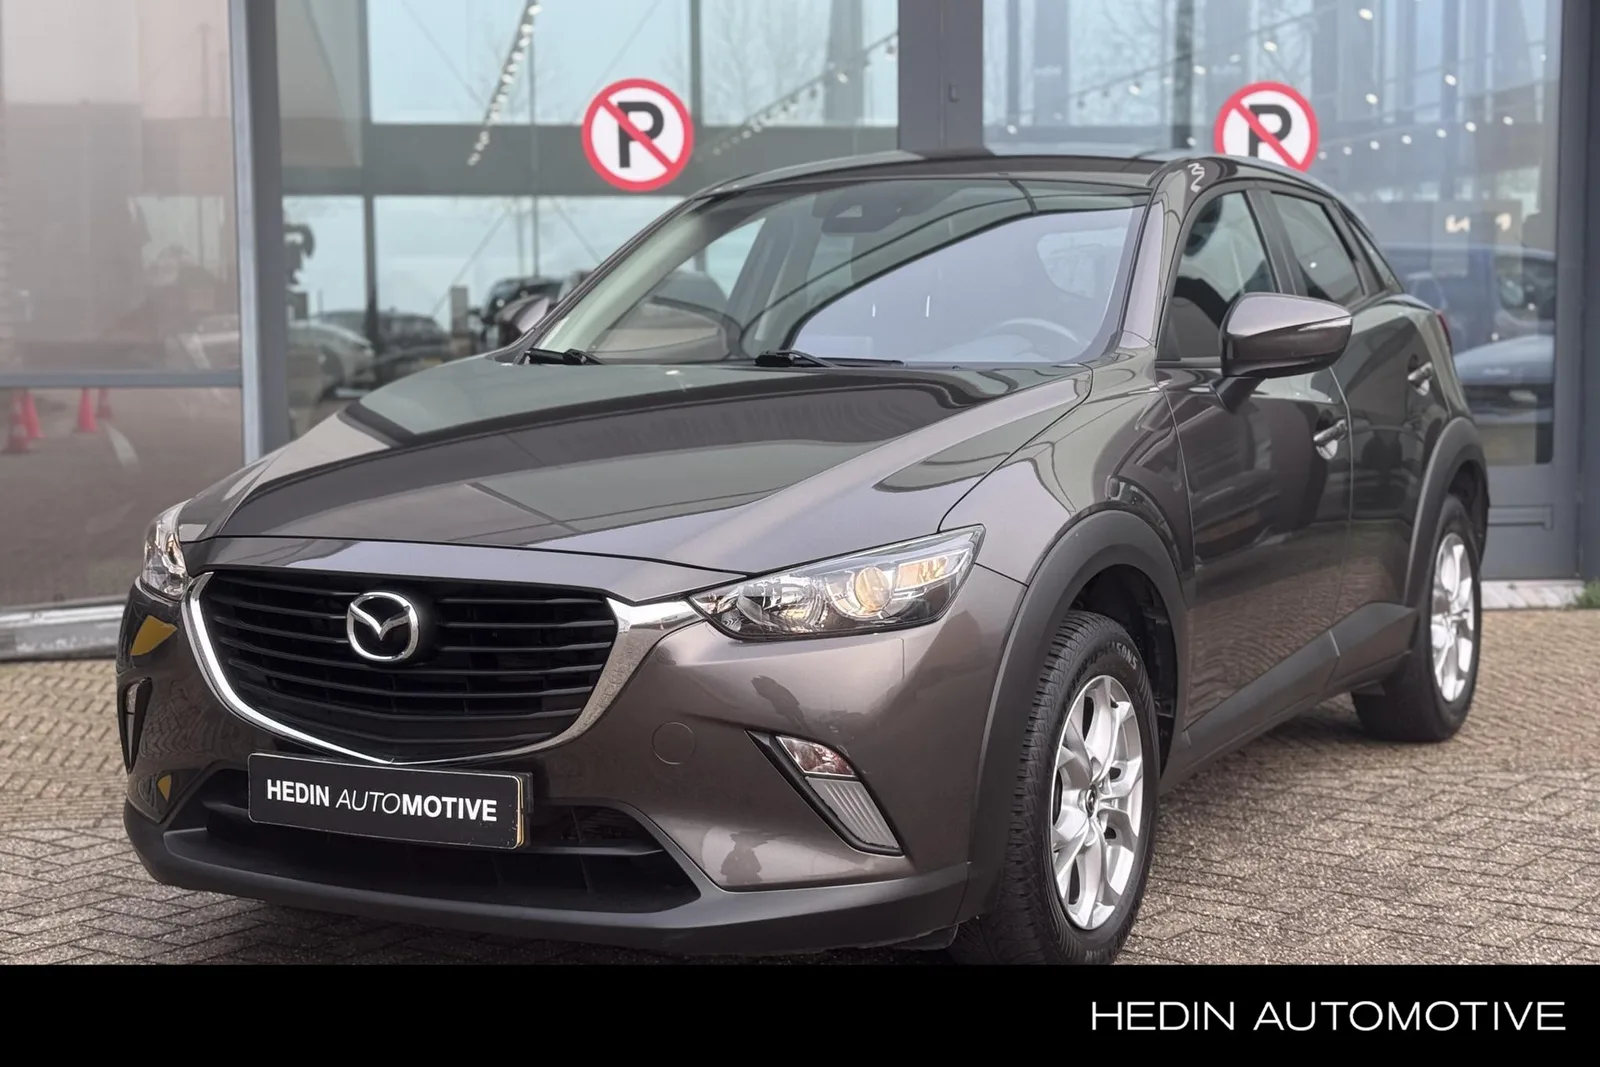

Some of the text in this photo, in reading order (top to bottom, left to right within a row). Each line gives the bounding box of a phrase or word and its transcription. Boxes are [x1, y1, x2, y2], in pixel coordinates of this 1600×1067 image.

[617, 101, 664, 168] P
[1248, 104, 1292, 158] P
[267, 779, 497, 821] HEDIN AUTOMOTIVE
